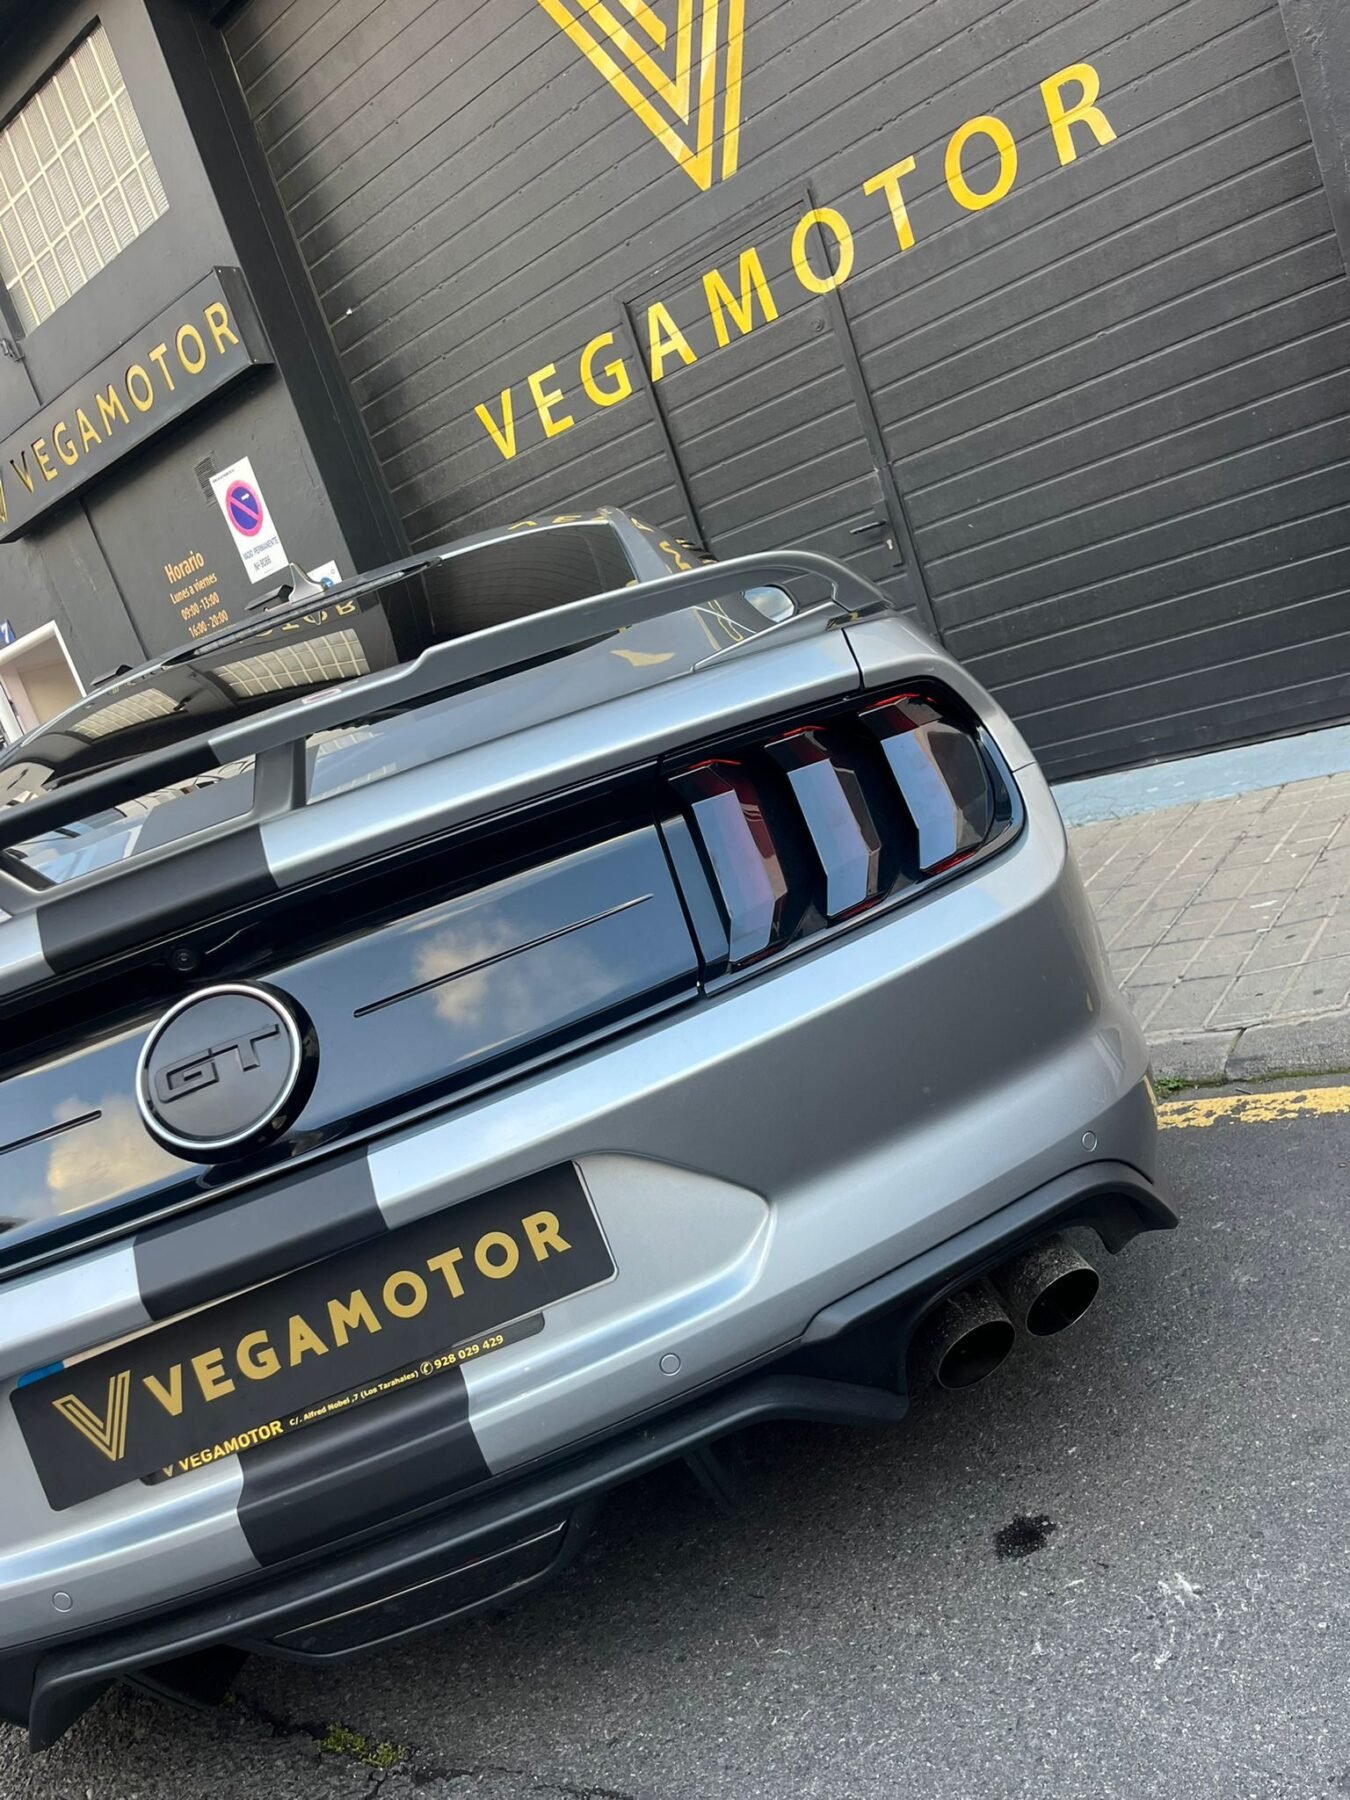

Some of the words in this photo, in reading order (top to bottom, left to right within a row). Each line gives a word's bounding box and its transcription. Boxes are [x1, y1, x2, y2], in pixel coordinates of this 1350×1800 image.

[474, 62, 1117, 461] VEGAMOTOR
[9, 301, 241, 494] VEGAMOTOR
[164, 550, 205, 584] Horario
[169, 586, 191, 605] Lunes
[189, 583, 196, 593] a
[194, 572, 218, 592] viernes
[181, 603, 200, 621] 09:00
[188, 620, 208, 639] 16:00
[211, 609, 229, 627] 20:00
[154, 1023, 280, 1104] GT
[143, 1211, 572, 1416] VEGAMOTOR
[178, 1420, 284, 1471] VEGAMOTOR
[303, 1406, 327, 1421] Alfred
[327, 1397, 350, 1411] Nobel
[360, 1385, 378, 1400] (Los
[378, 1370, 419, 1391] Tarahales)
[433, 1354, 457, 1369] 928
[457, 1344, 480, 1360] 029
[482, 1334, 504, 1350] 429
